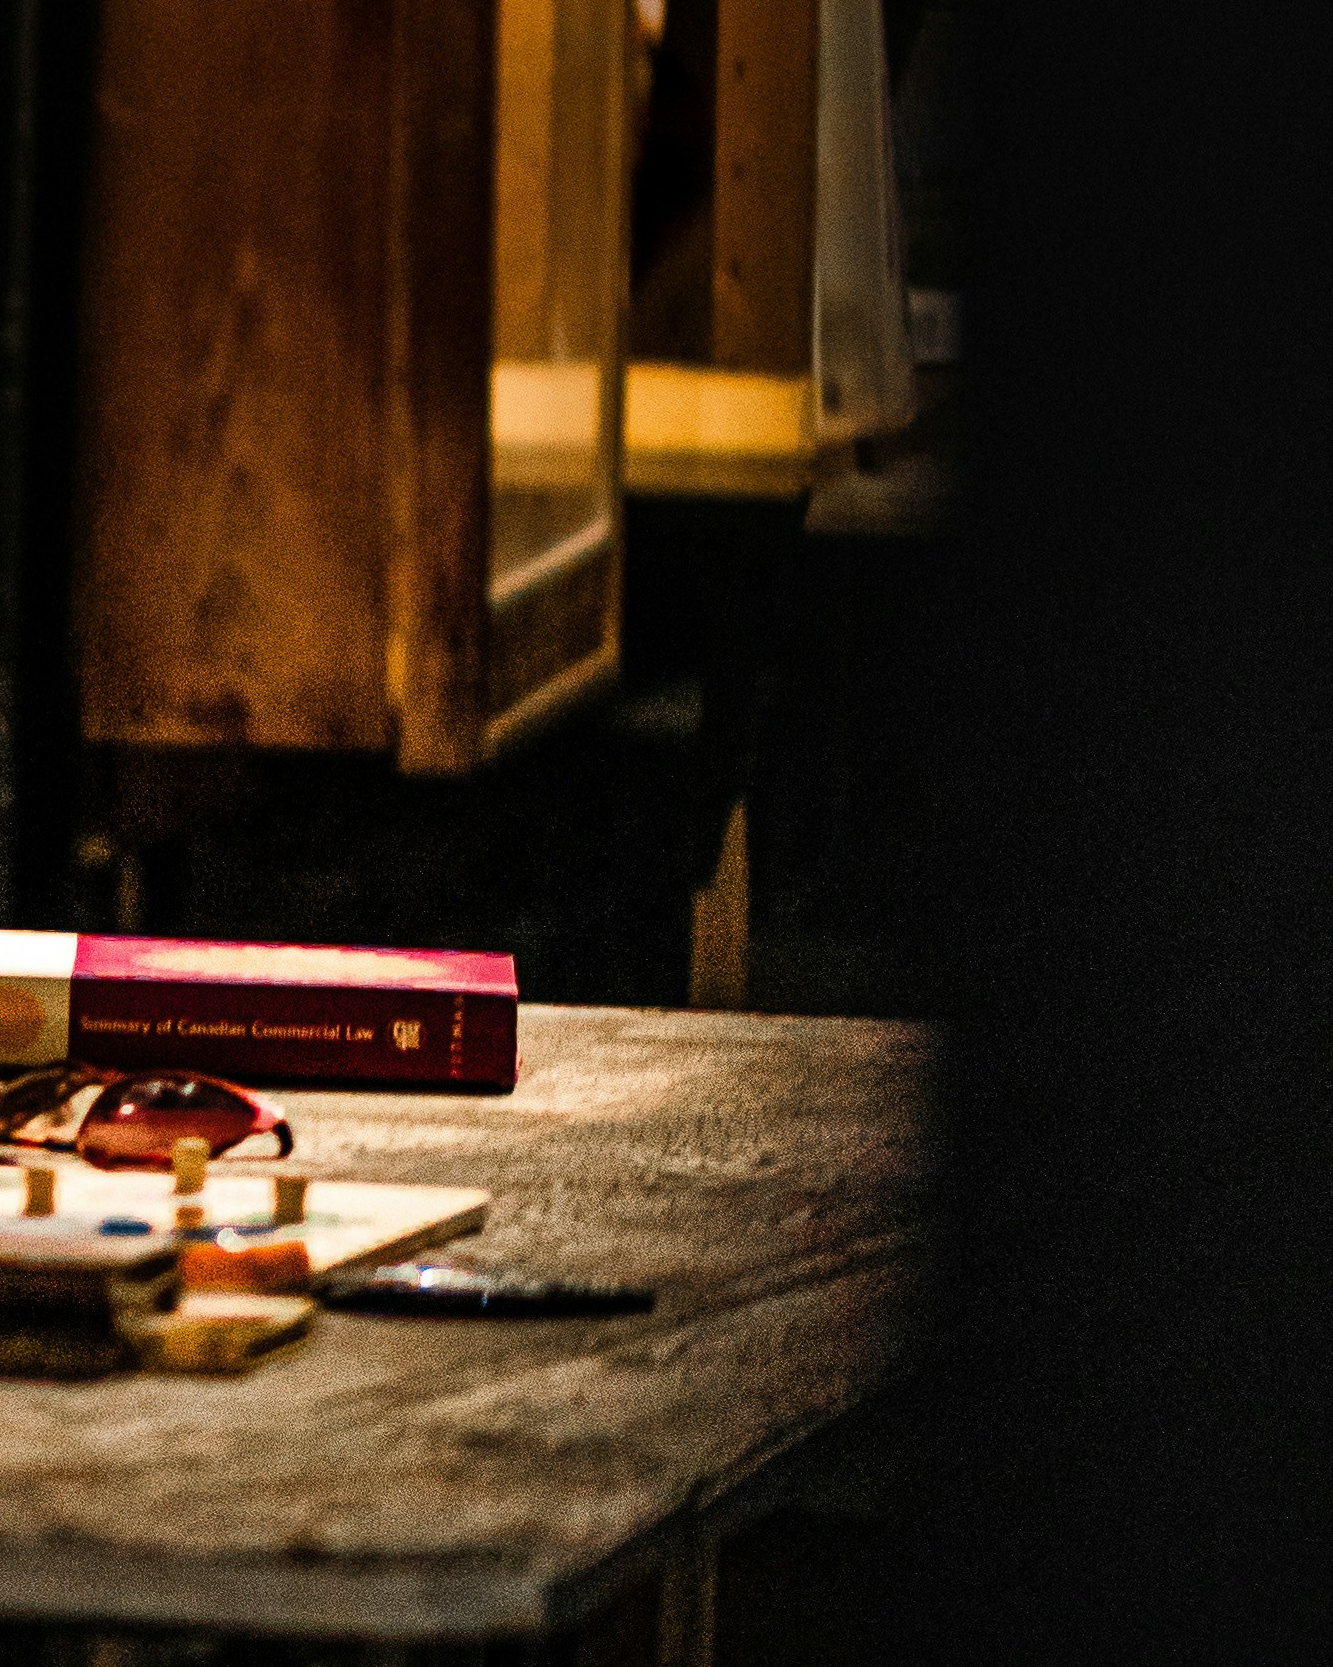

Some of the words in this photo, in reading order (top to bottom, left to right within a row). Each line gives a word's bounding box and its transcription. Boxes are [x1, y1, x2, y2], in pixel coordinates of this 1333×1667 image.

[81, 1016, 152, 1037] Summary
[155, 1018, 172, 1036] of
[177, 1018, 247, 1038] Canadian
[250, 1019, 341, 1042] Commercial
[345, 1023, 374, 1042] Law
